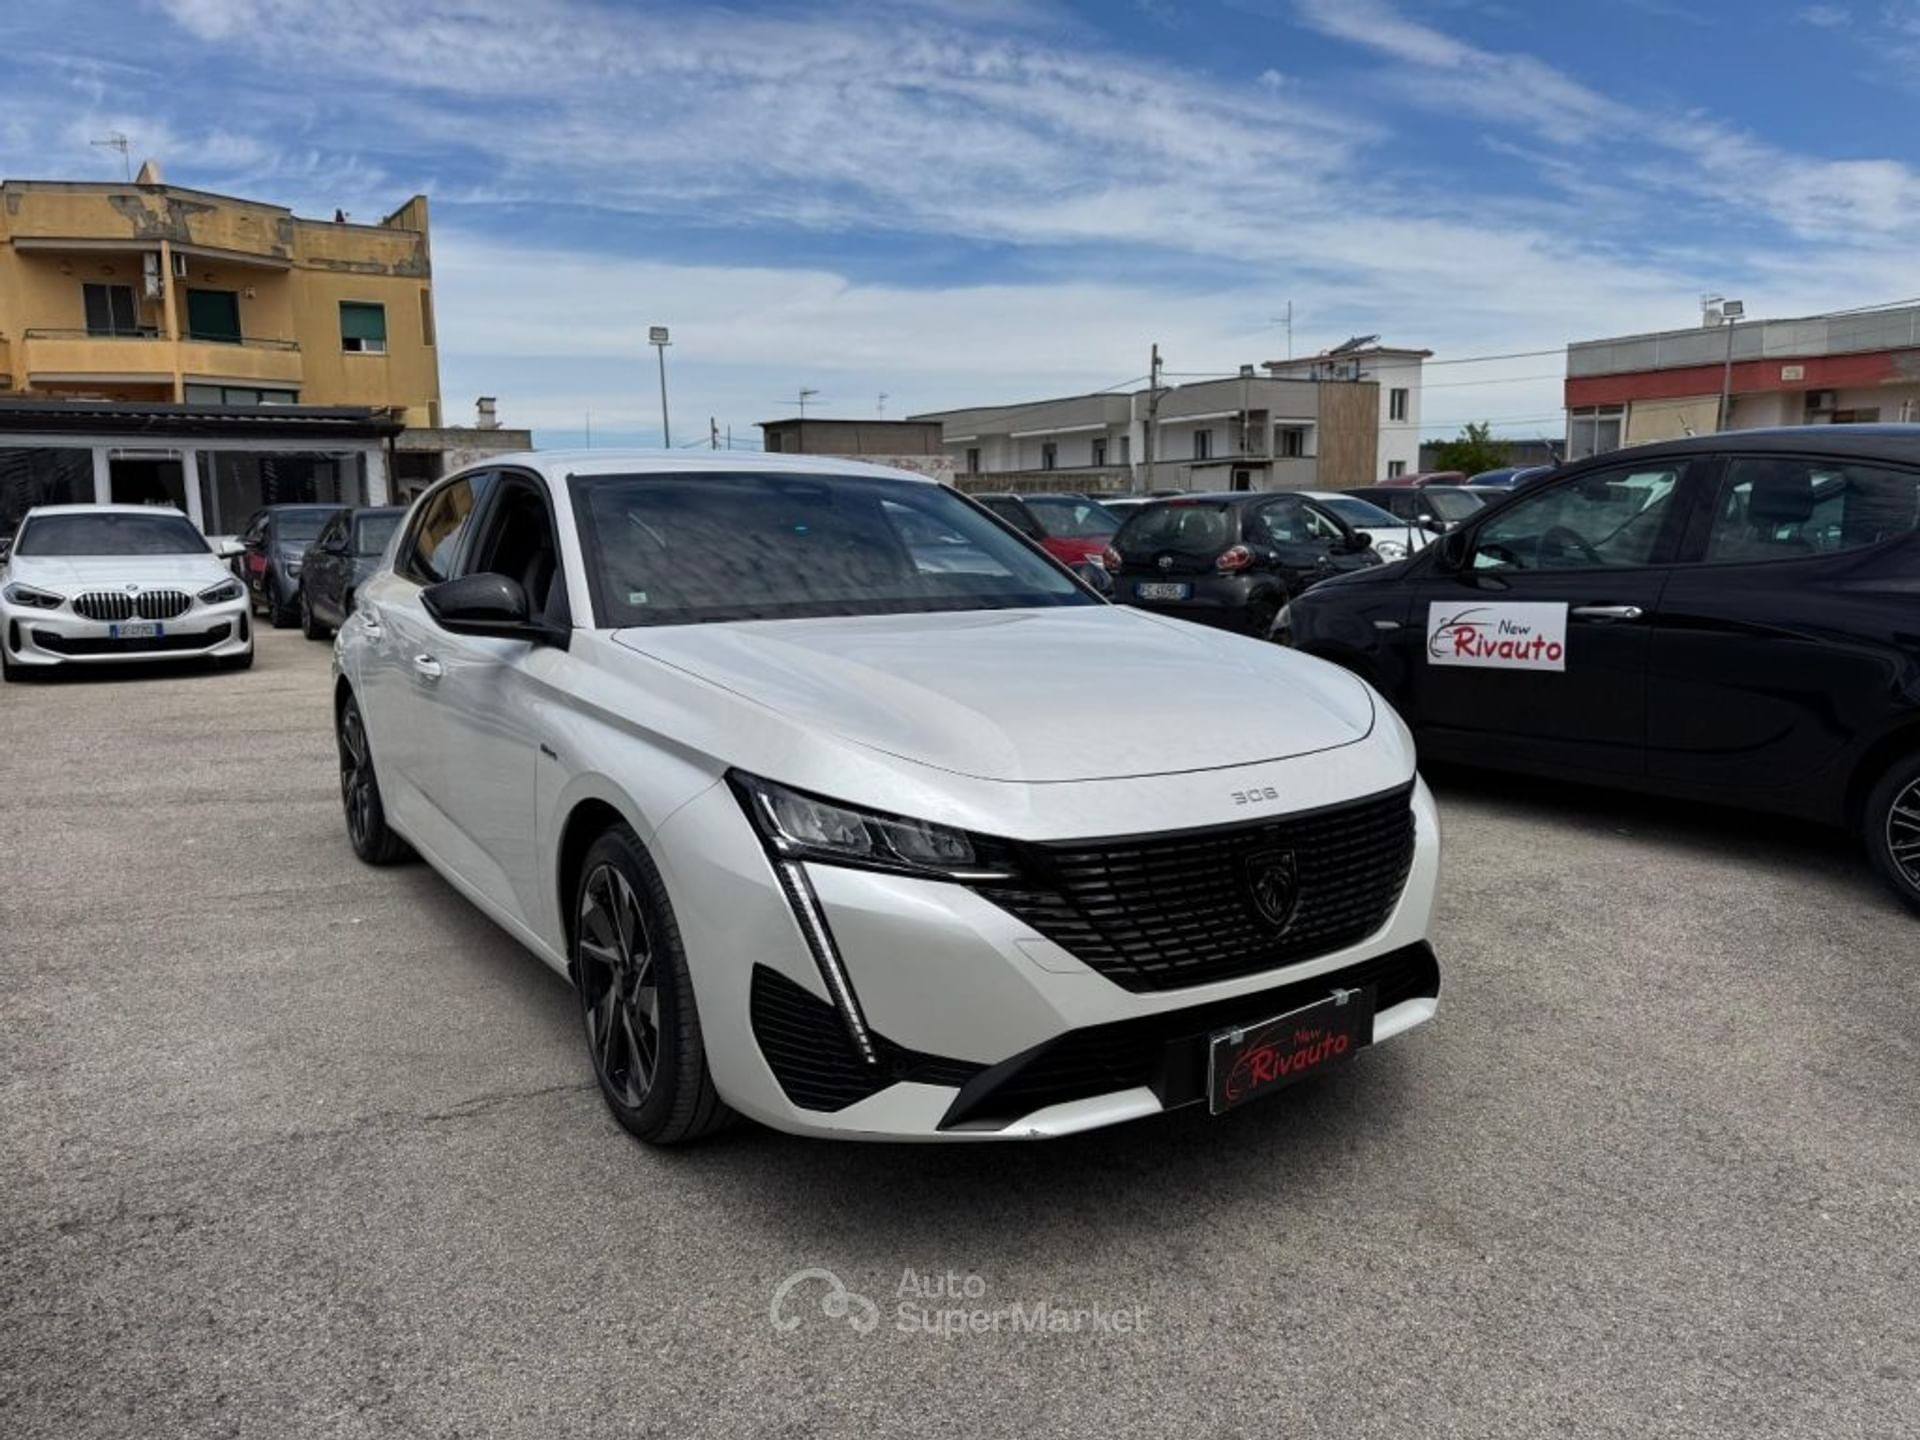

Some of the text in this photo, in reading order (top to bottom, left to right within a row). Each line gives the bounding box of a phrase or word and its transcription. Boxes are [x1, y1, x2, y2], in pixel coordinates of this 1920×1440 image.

[1498, 619, 1531, 635] New
[1453, 626, 1562, 661] Rivauto
[1231, 787, 1279, 805] 308
[1249, 1033, 1349, 1088] Rivauto
